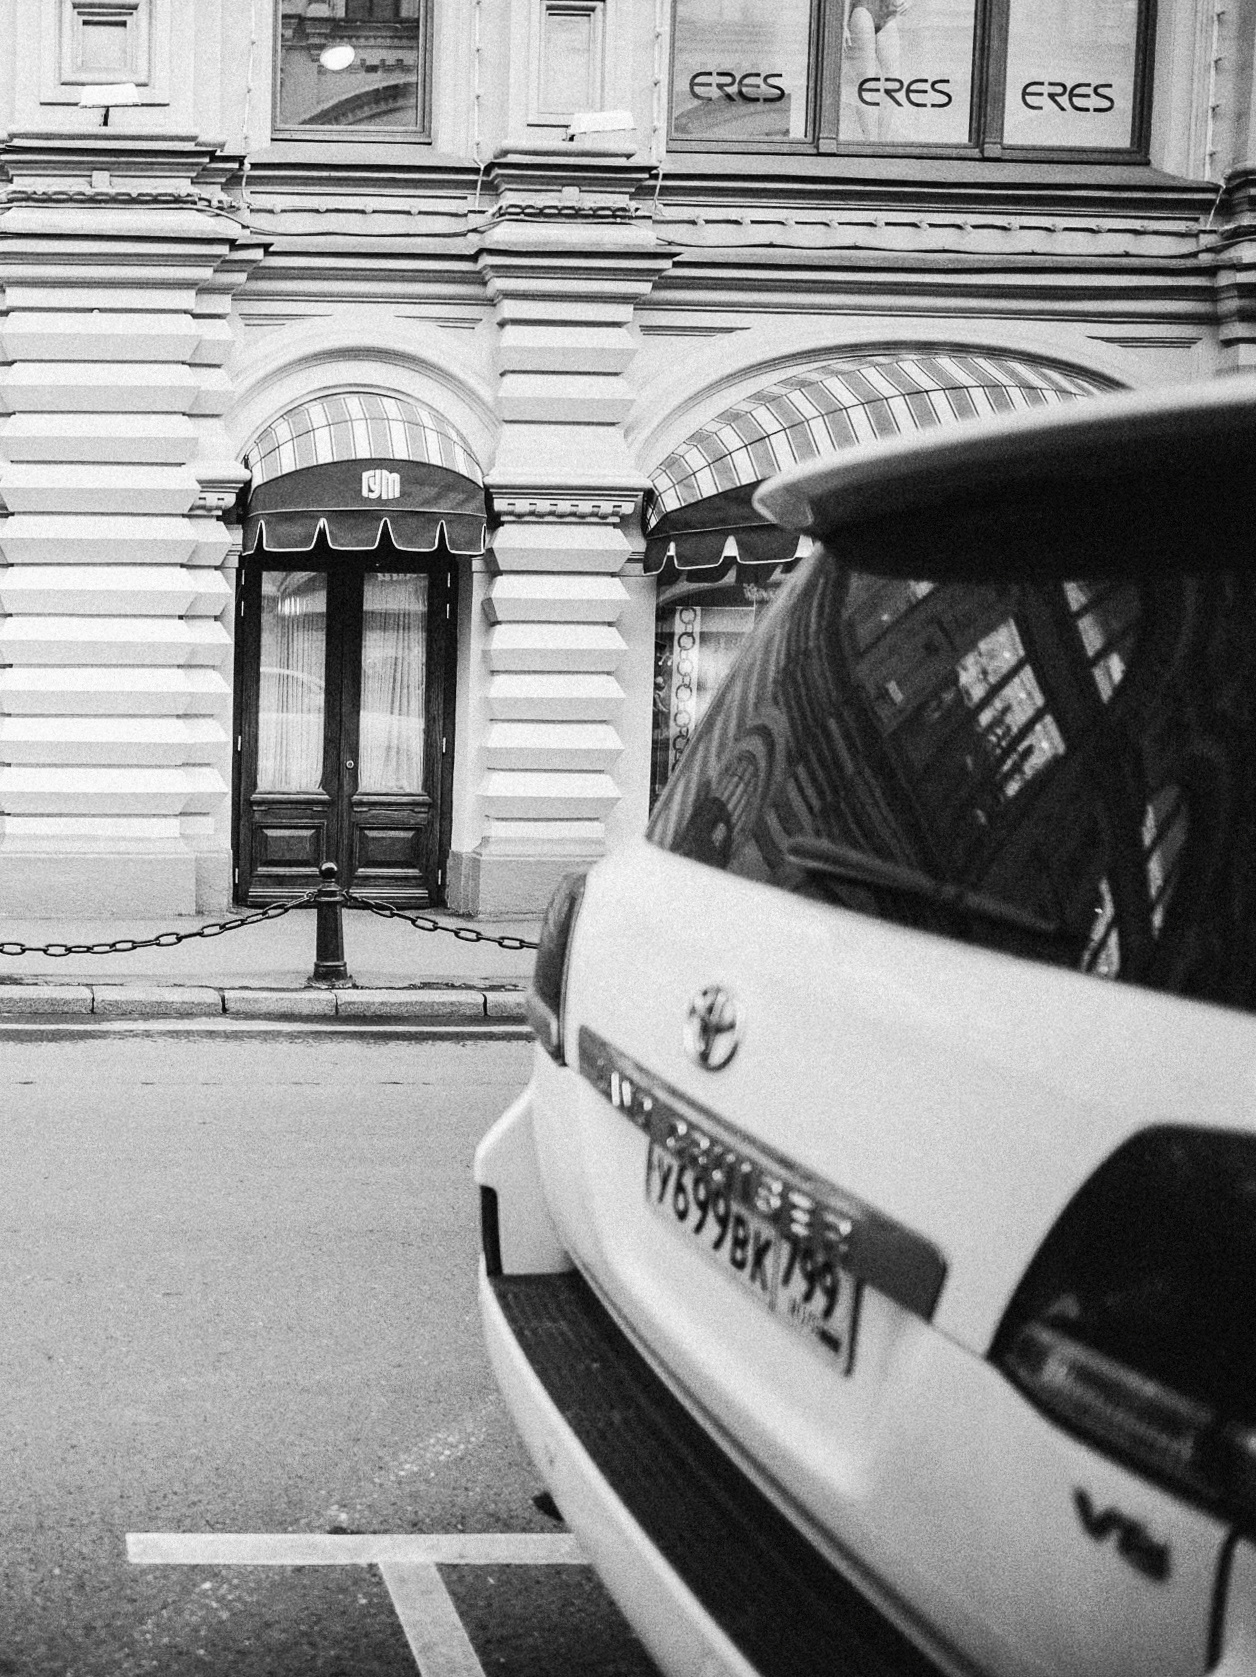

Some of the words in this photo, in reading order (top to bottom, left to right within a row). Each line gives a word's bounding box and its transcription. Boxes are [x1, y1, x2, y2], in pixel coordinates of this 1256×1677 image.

[688, 70, 786, 103] ERES
[856, 76, 953, 109] ERES
[1020, 80, 1116, 113] ERES
